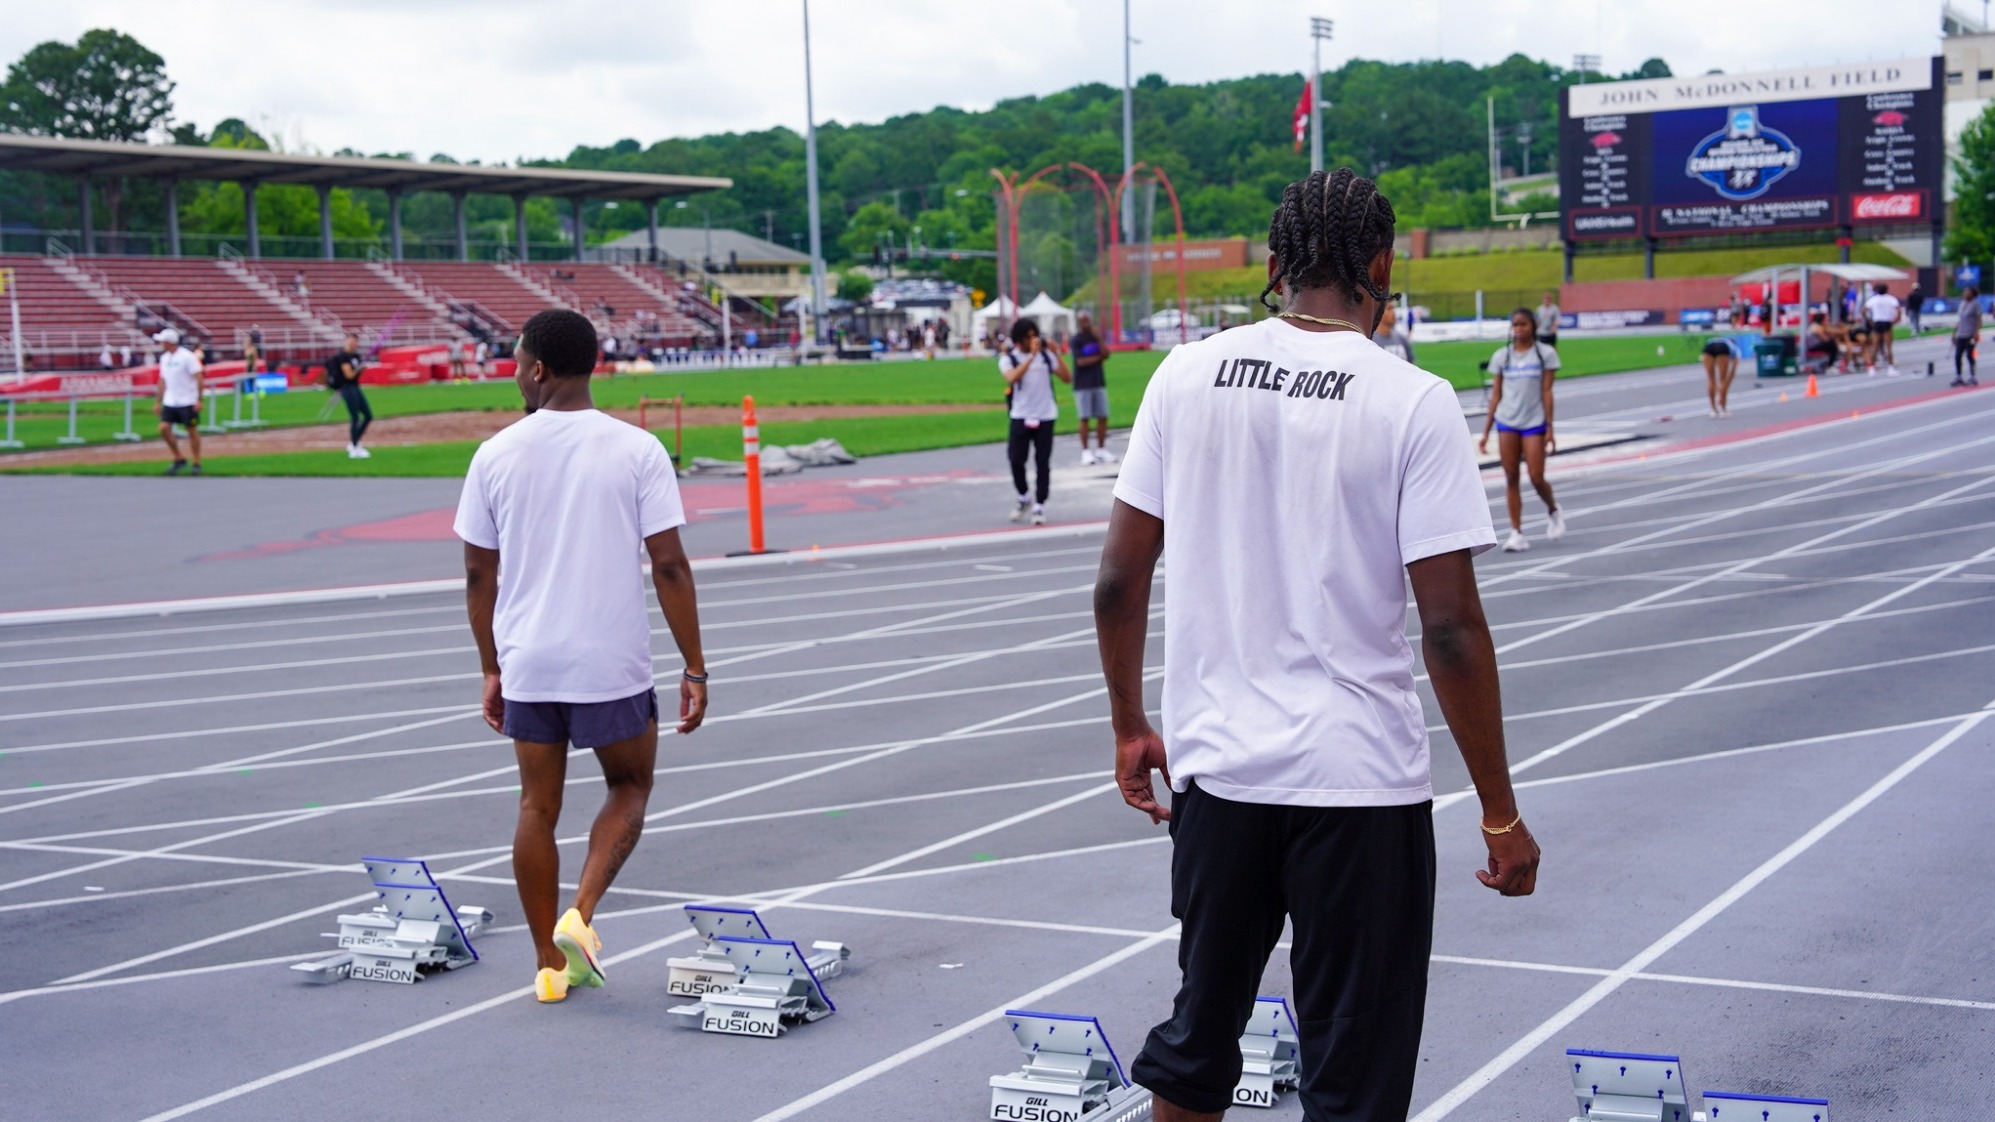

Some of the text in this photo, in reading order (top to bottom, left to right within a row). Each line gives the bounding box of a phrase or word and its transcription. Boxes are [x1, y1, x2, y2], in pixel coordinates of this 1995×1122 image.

[1599, 89, 1659, 106] JOHN
[1831, 67, 1901, 87] FIELD
[1213, 358, 1356, 401] LITTLE ROCK
[353, 966, 412, 981] FUSION
[694, 974, 713, 982] GILL
[731, 1010, 750, 1019] GILL
[705, 1017, 774, 1034] FUSION
[1025, 1096, 1048, 1106] GILL
[994, 1104, 1078, 1122] FUSION
